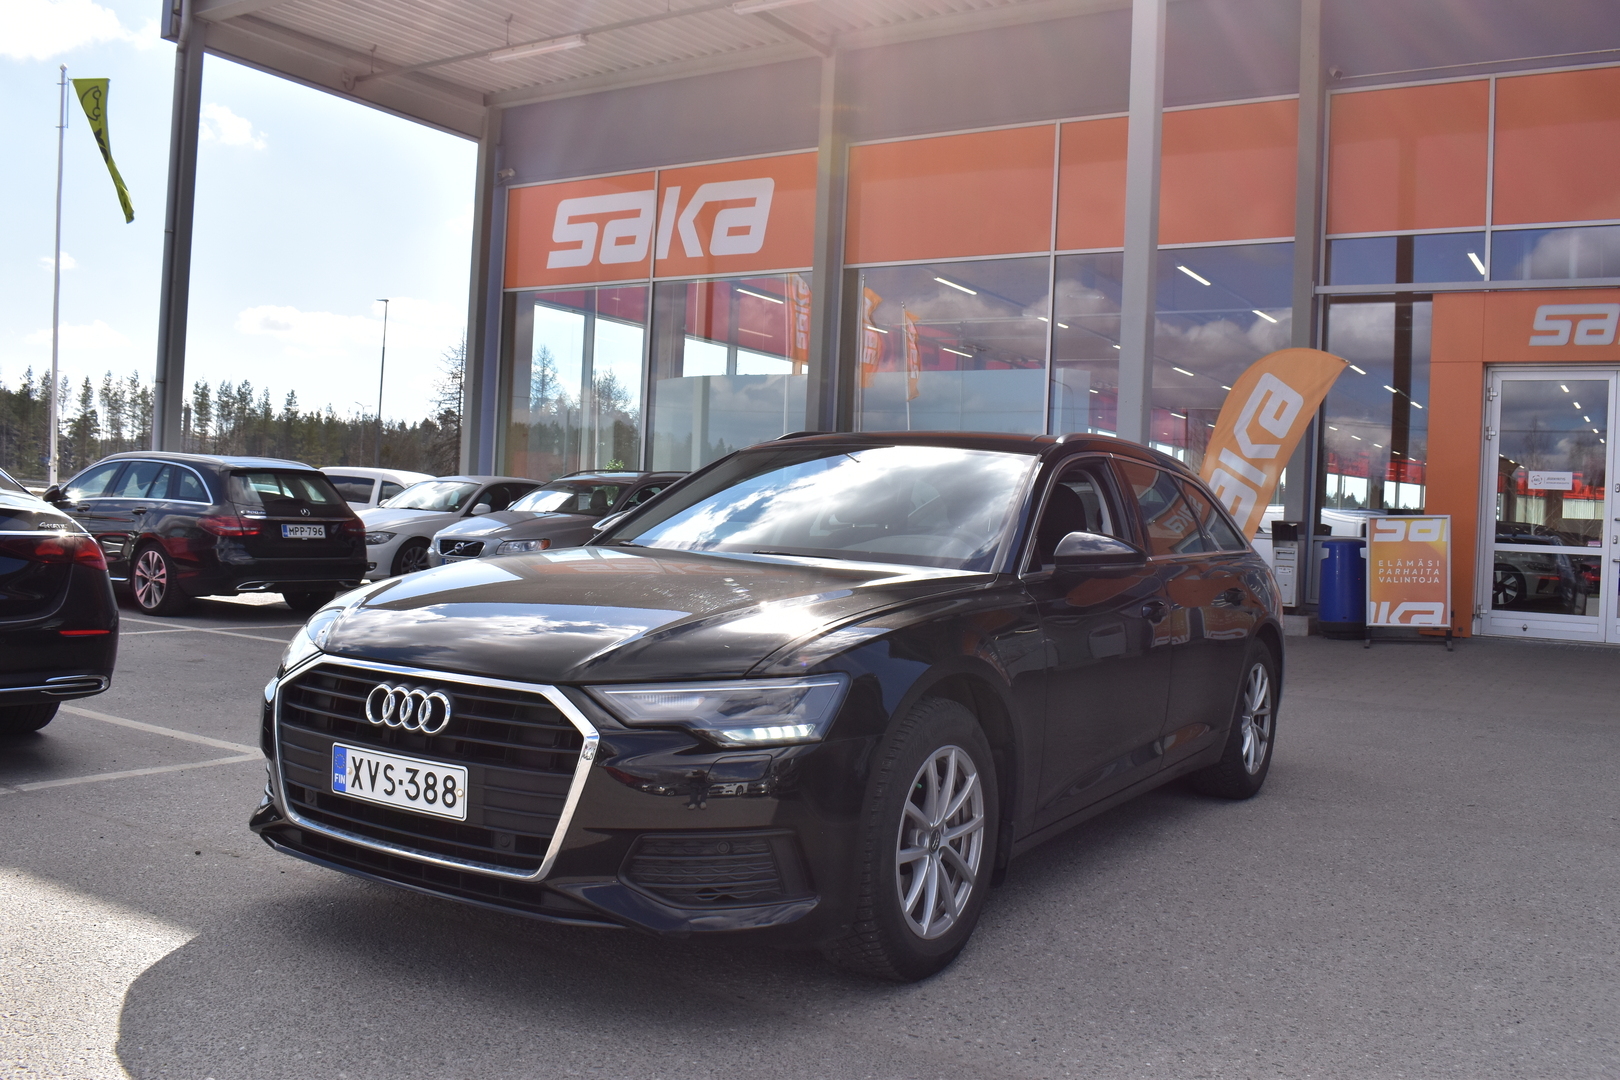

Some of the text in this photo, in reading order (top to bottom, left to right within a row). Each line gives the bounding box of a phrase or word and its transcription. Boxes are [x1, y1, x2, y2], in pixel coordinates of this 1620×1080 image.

[288, 526, 324, 536] MPP-796
[1378, 559, 1440, 567] ELÄMÄSI
[334, 756, 457, 808] FIN XVS-388
